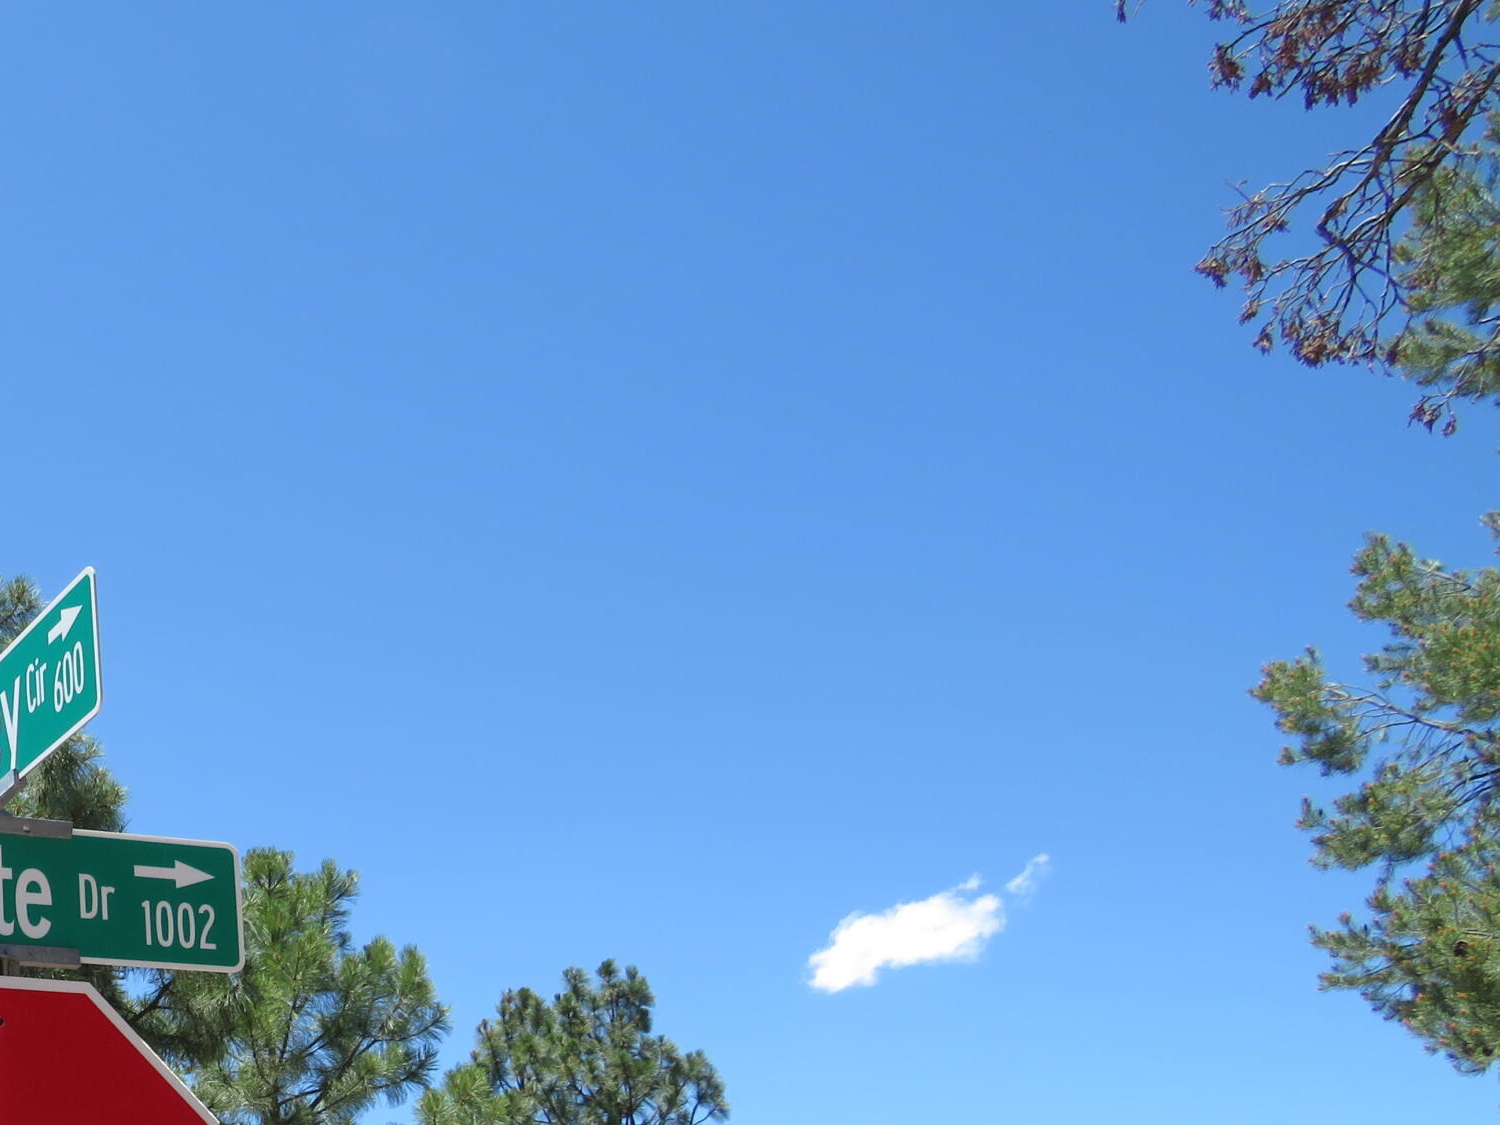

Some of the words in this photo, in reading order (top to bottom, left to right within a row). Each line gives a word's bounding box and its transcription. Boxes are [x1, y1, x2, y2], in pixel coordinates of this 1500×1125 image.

[26, 657, 47, 714] Cir
[53, 640, 85, 713] 600
[78, 873, 115, 921] Dr
[141, 899, 217, 950] 1002
